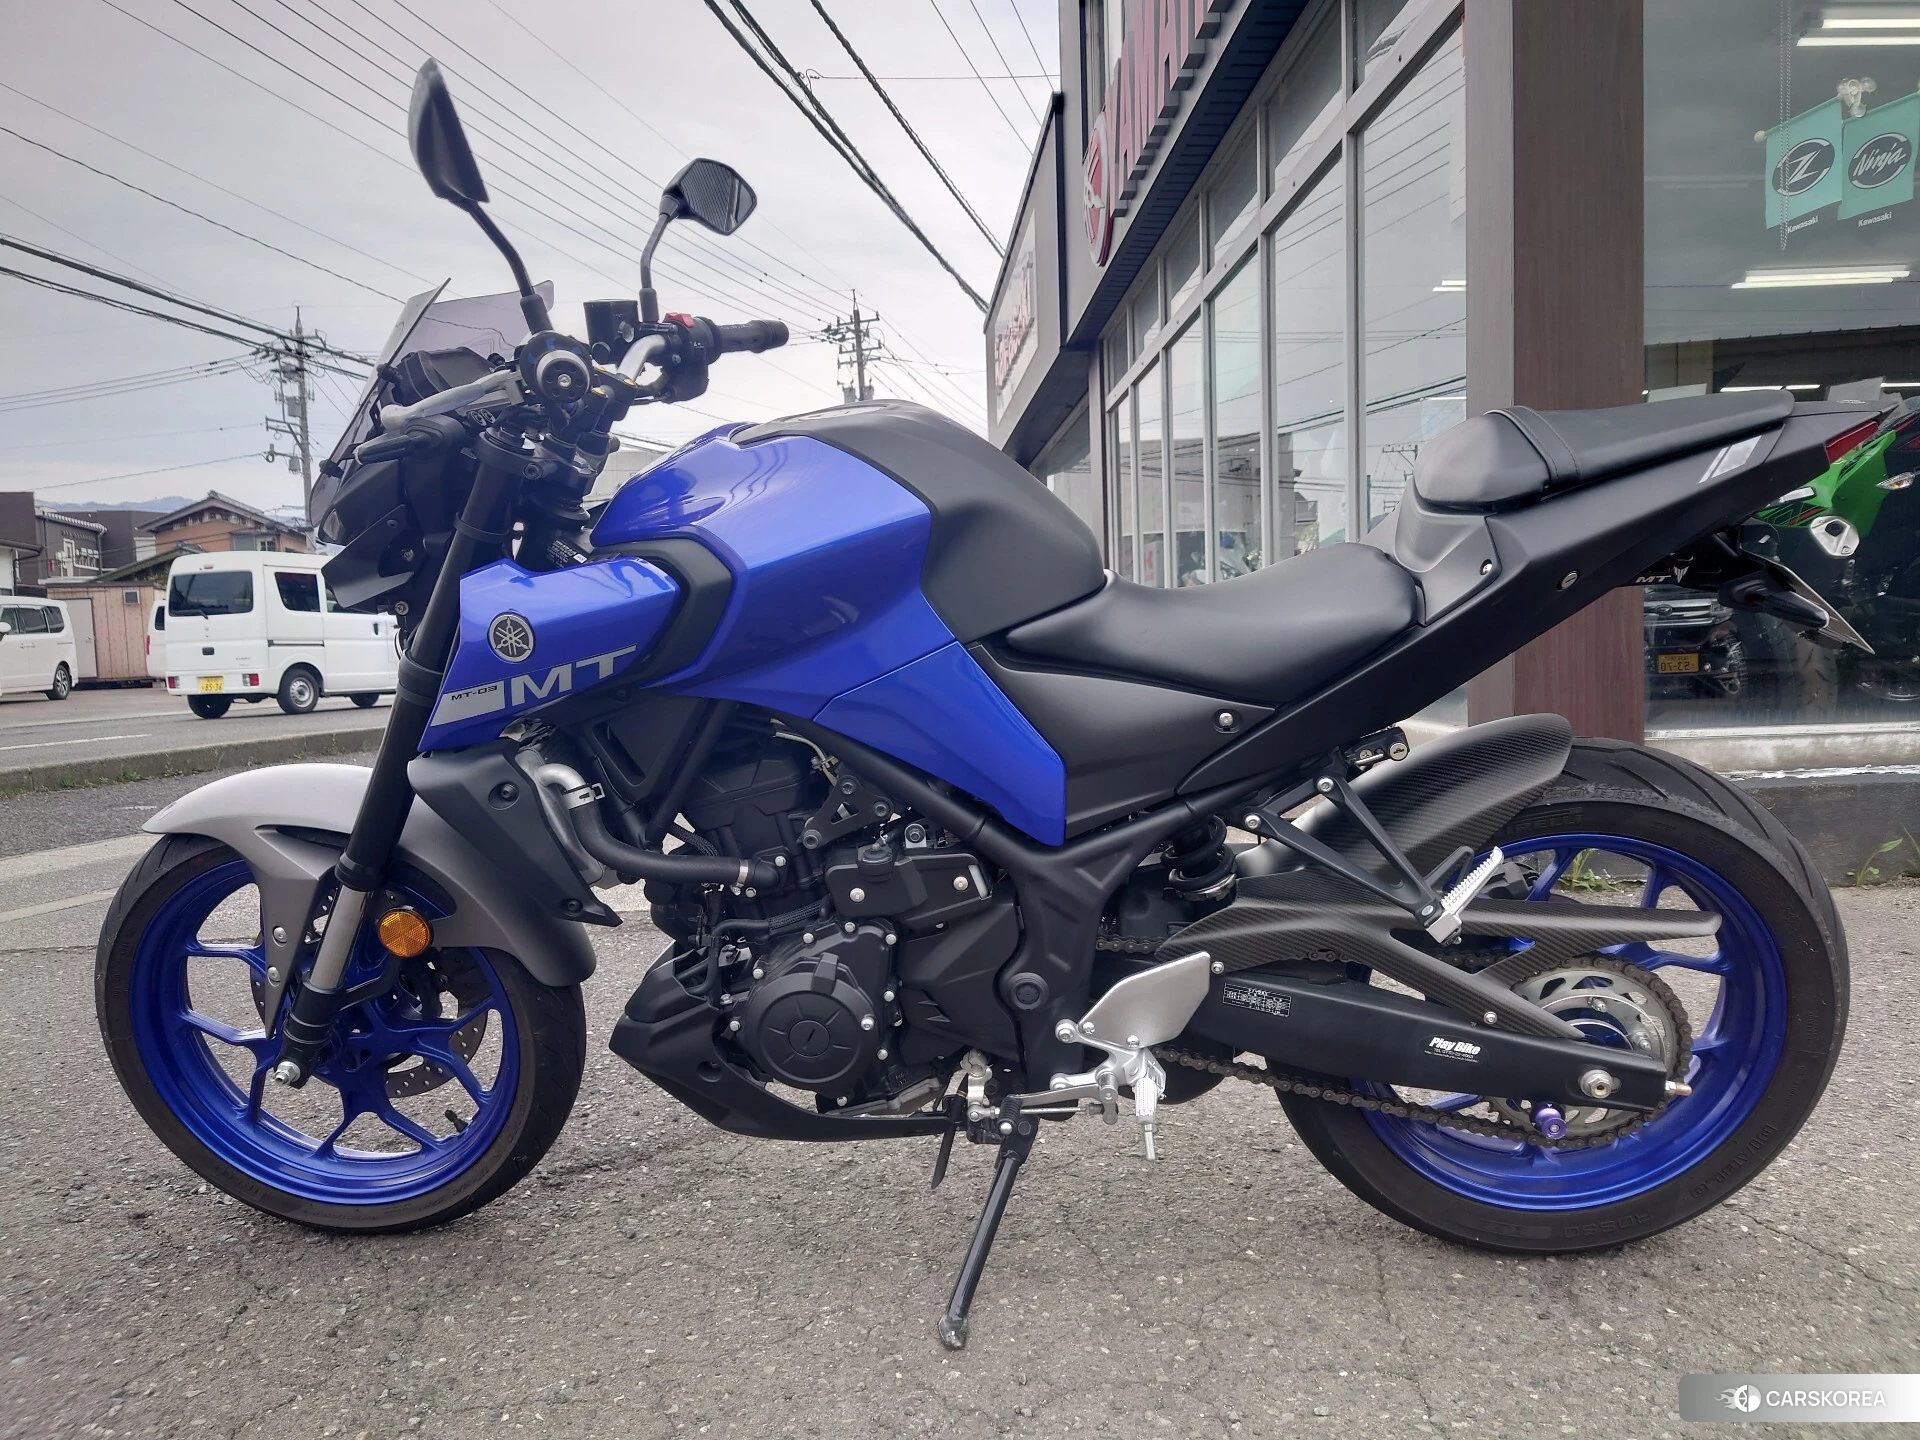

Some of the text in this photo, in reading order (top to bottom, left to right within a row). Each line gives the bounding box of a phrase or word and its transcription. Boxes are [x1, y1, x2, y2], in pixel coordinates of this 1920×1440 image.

[1105, 0, 1233, 217] YAMA
[1787, 149, 1822, 185] Z
[1853, 142, 1907, 177] Ninja
[1786, 215, 1819, 234] Kawasaki
[1858, 211, 1892, 227] Kawasaki
[1636, 575, 1671, 583] MT
[510, 643, 637, 707] MT
[451, 684, 498, 701] MT-03
[1428, 1036, 1481, 1055] Play Bike
[1563, 1211, 1652, 1239] ROSSO
